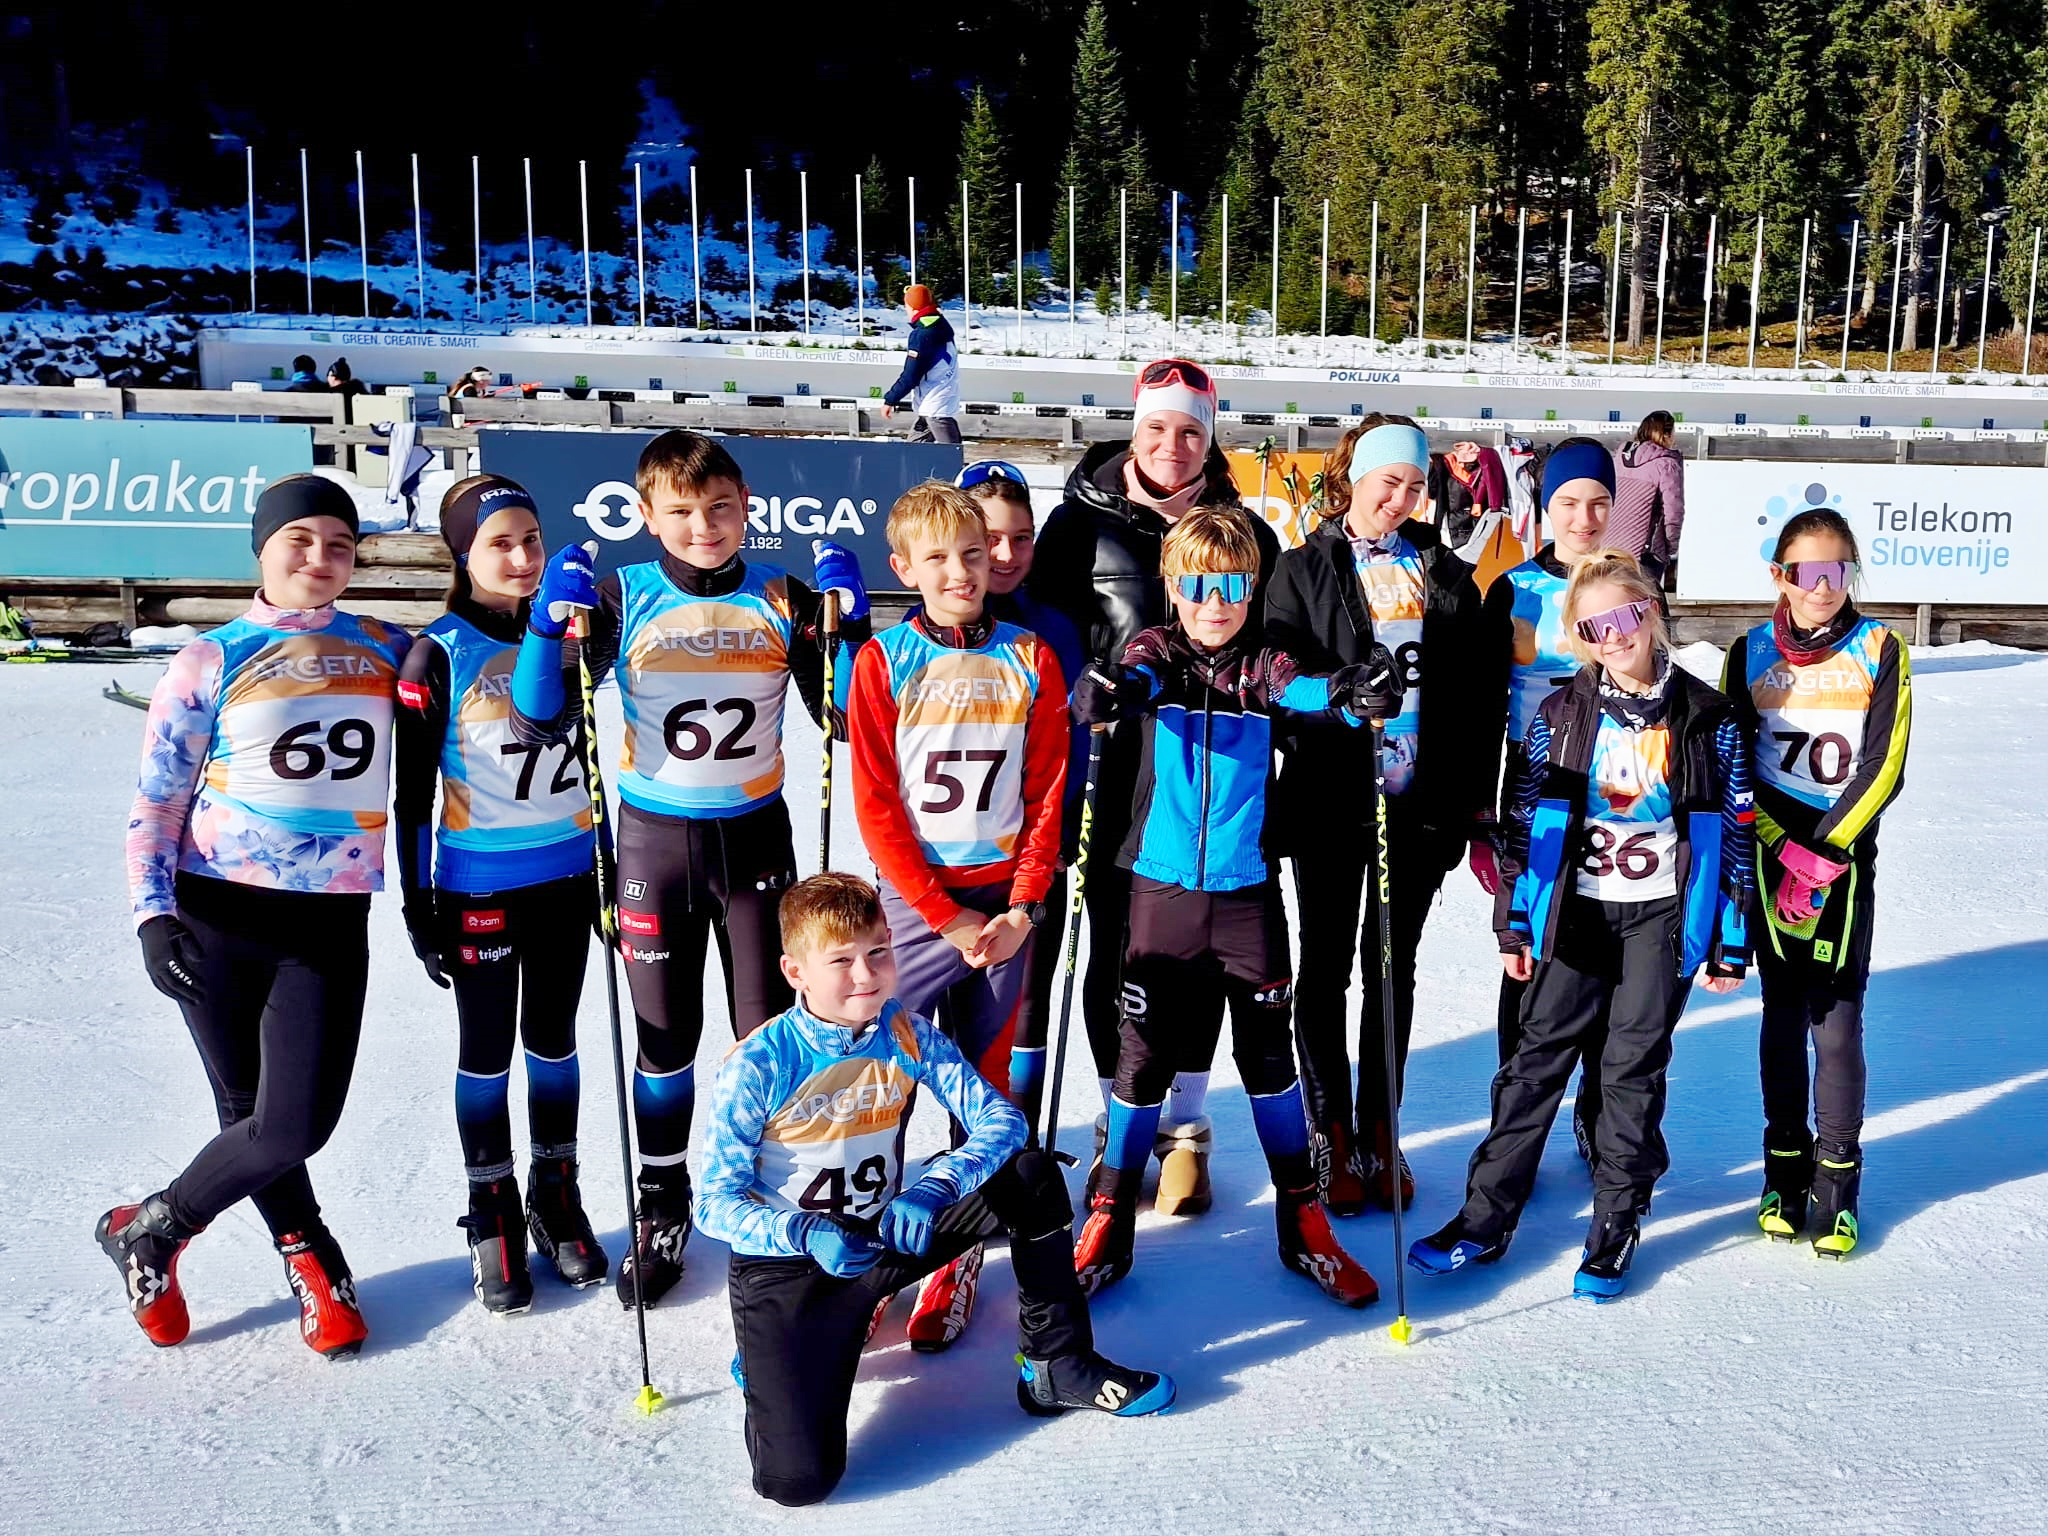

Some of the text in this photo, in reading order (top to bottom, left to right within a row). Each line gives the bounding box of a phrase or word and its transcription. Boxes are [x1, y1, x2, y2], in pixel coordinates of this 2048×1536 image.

[342, 333, 480, 349] GREEN. CREATIVE. SMART.
[755, 347, 792, 360] GREEN.
[849, 351, 887, 364] SMART.
[1201, 366, 1268, 379] ATIVE. SMART.
[1329, 370, 1401, 384] POKLJUKA
[1488, 375, 1604, 389] GREEN. CREATIVE. SMART.
[1835, 384, 1867, 395] GREEN.
[1869, 385, 1914, 396] CREATIVE.
[1872, 502, 2012, 534] Telekom
[749, 536, 783, 550] 1922
[1870, 537, 2010, 575] Slovenije
[648, 624, 769, 657] ARGETA
[252, 654, 379, 684] ARGETA
[1762, 668, 1863, 696] ARGETA
[402, 690, 422, 702] sam
[907, 677, 1022, 709] ARGETA
[663, 697, 757, 761] 62
[269, 718, 376, 781] 69
[1772, 731, 1853, 785] 70
[500, 741, 579, 801] 72
[919, 749, 1008, 814] 57
[1582, 825, 1659, 881] 86
[480, 915, 500, 927] sam
[631, 919, 652, 931] sam
[478, 944, 512, 962] triglav
[632, 949, 670, 965] triglav
[785, 1082, 902, 1126] ARGETA
[798, 1154, 889, 1215] 49
